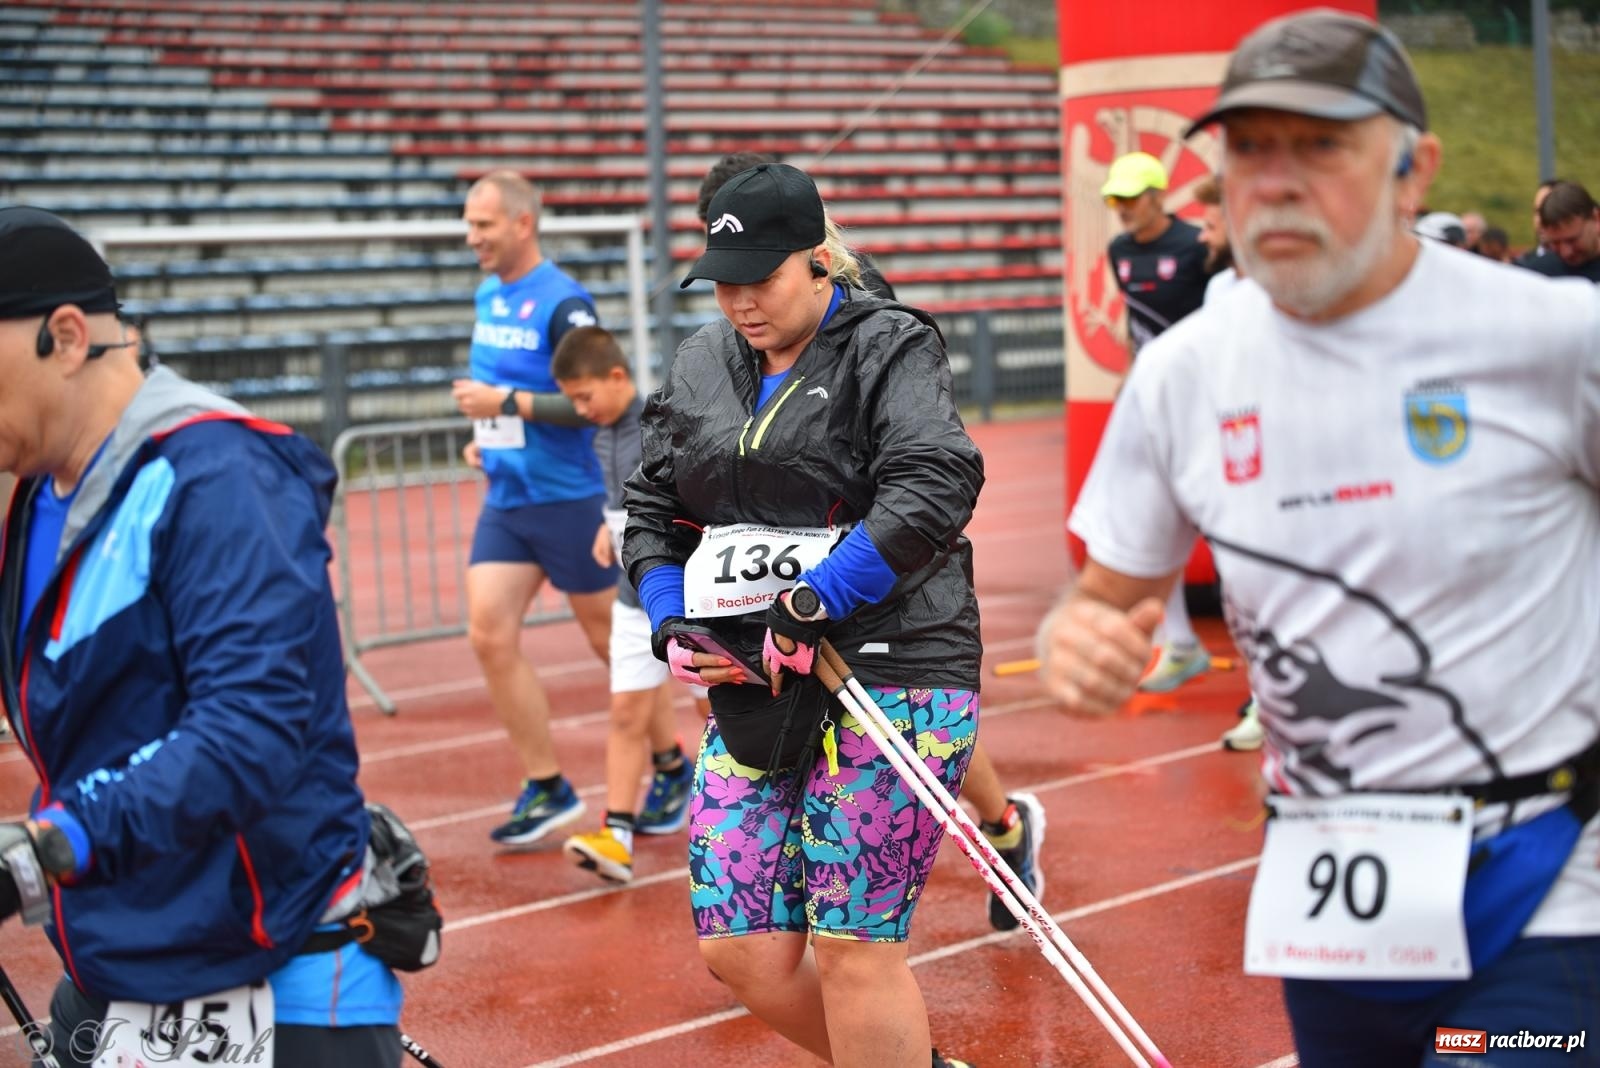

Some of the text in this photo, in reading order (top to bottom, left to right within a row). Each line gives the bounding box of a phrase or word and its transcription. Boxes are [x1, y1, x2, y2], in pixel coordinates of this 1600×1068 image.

[714, 544, 801, 584] 136
[717, 592, 774, 608] Racibórz
[1307, 851, 1388, 921] 90
